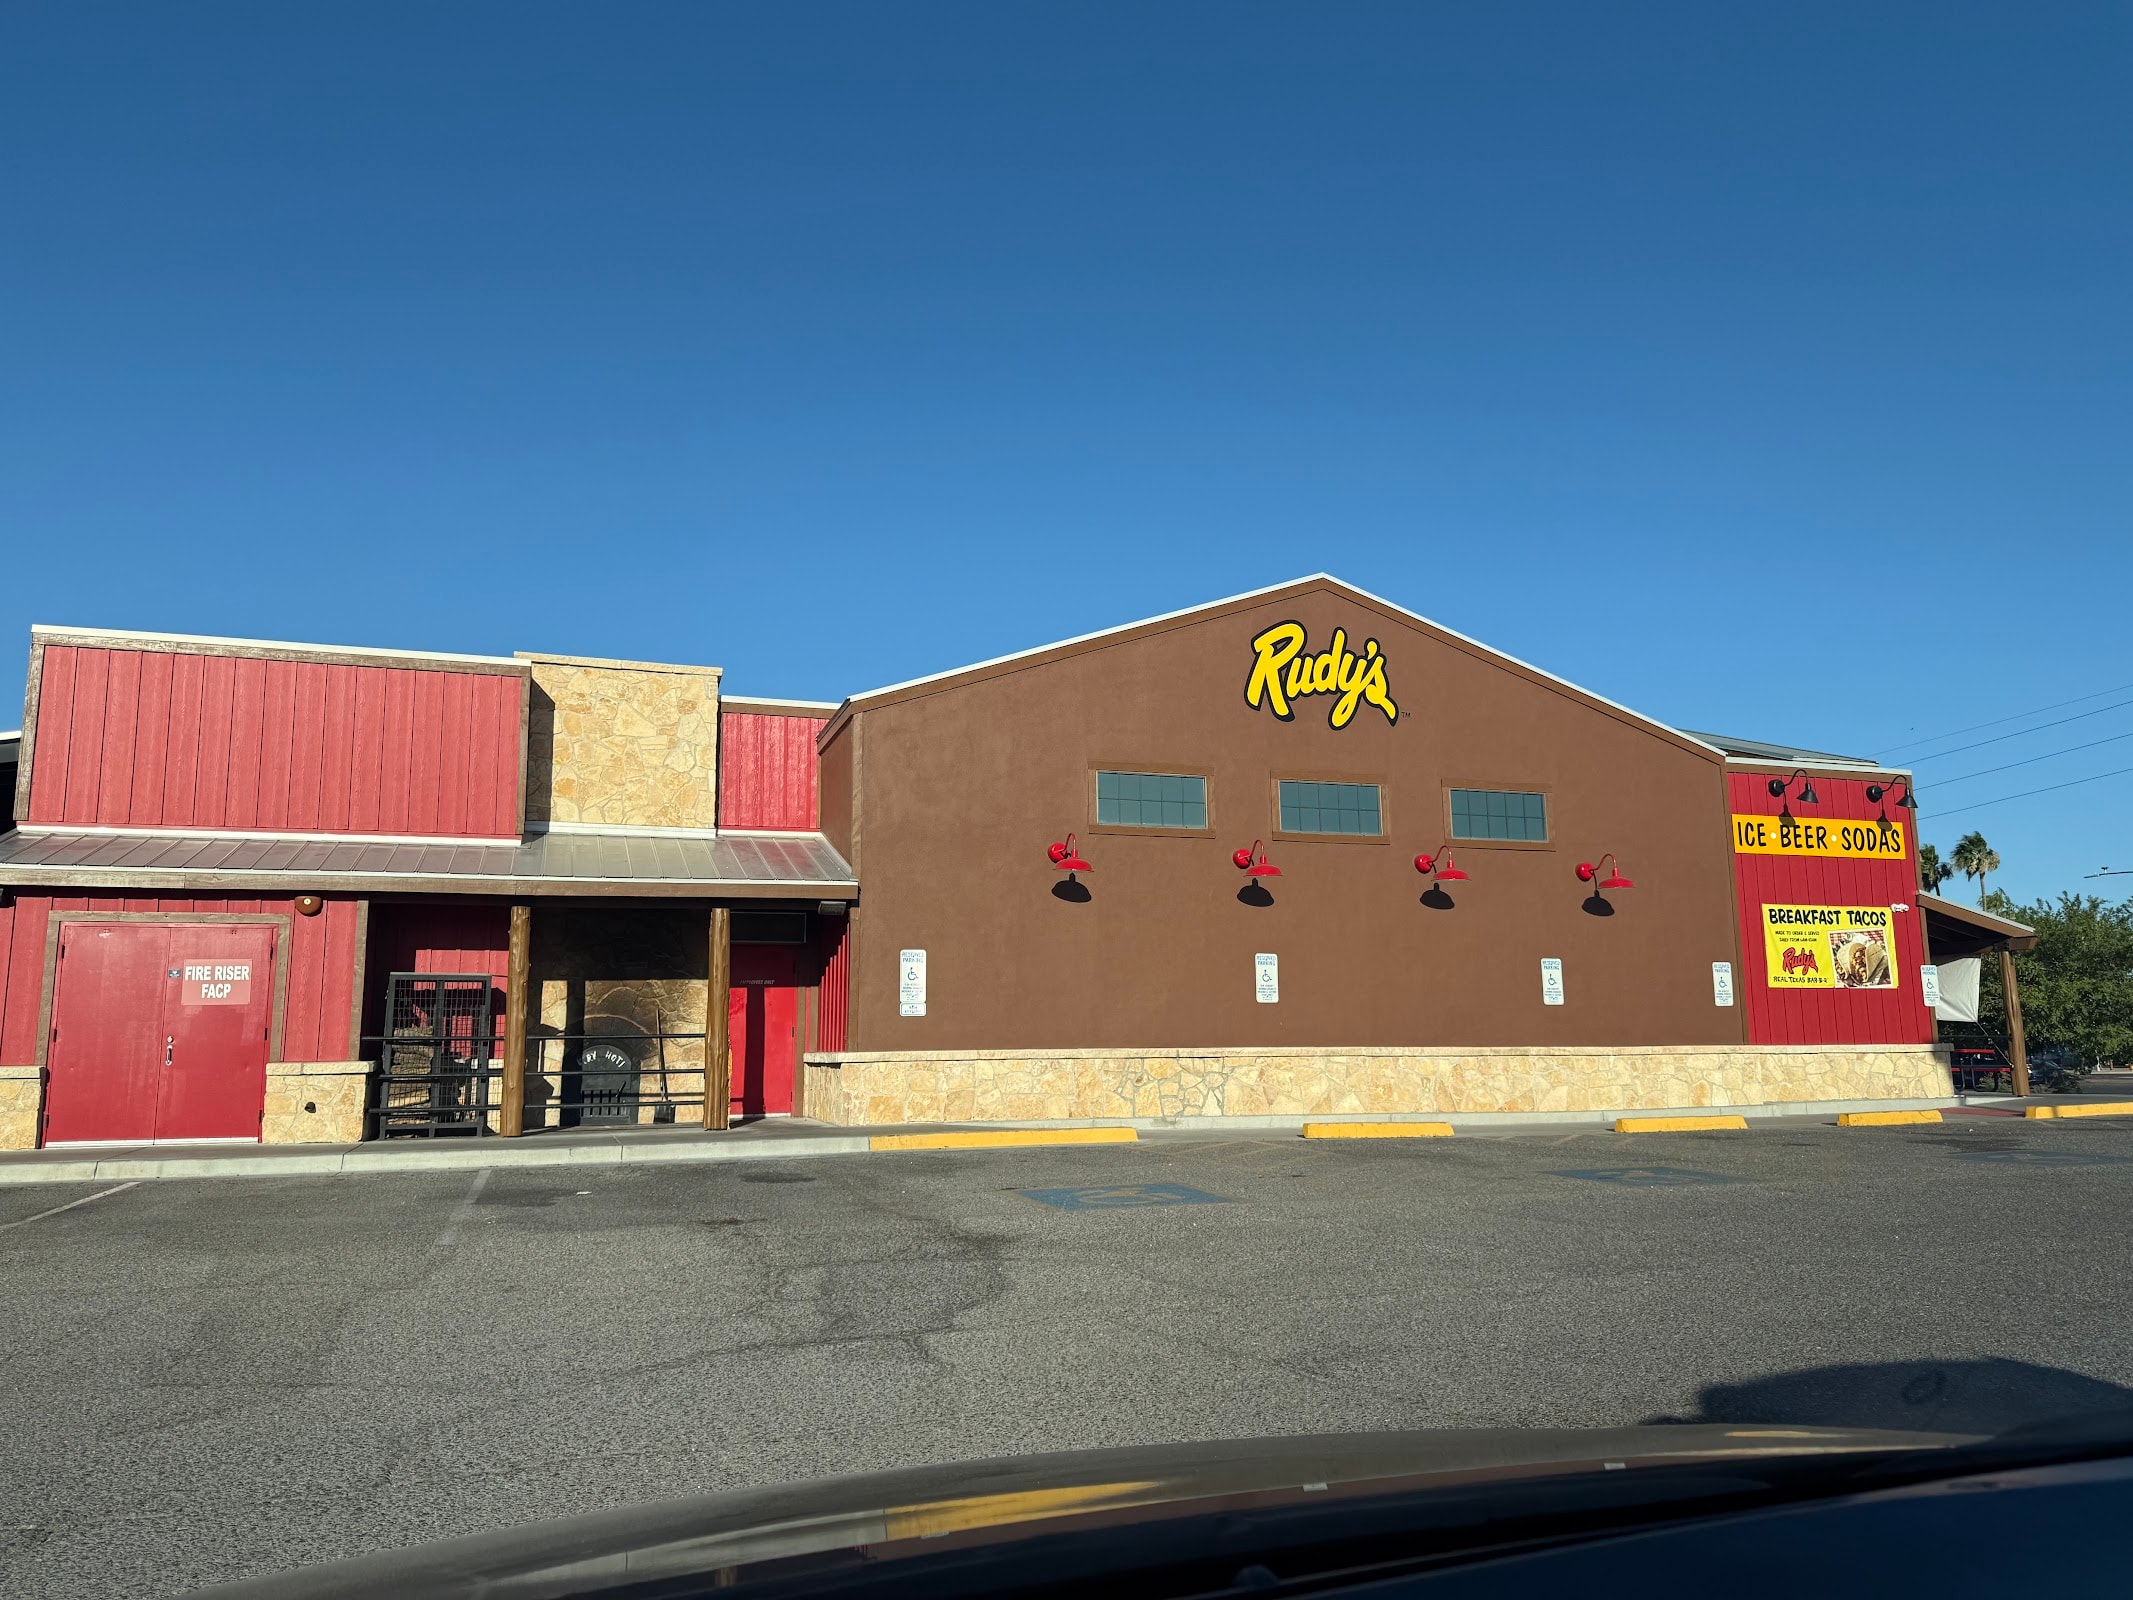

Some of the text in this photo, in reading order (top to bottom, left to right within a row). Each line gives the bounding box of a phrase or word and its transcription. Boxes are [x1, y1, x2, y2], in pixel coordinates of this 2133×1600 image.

[1244, 619, 1399, 731] Rudy's
[1737, 822, 1901, 853] ICE BEER SODAS
[1768, 908, 1887, 927] BREAKFAST TACOS
[184, 965, 211, 981] FIRE
[214, 965, 250, 981] RISER
[1782, 947, 1819, 976] Rudy's
[201, 983, 232, 999] FACP
